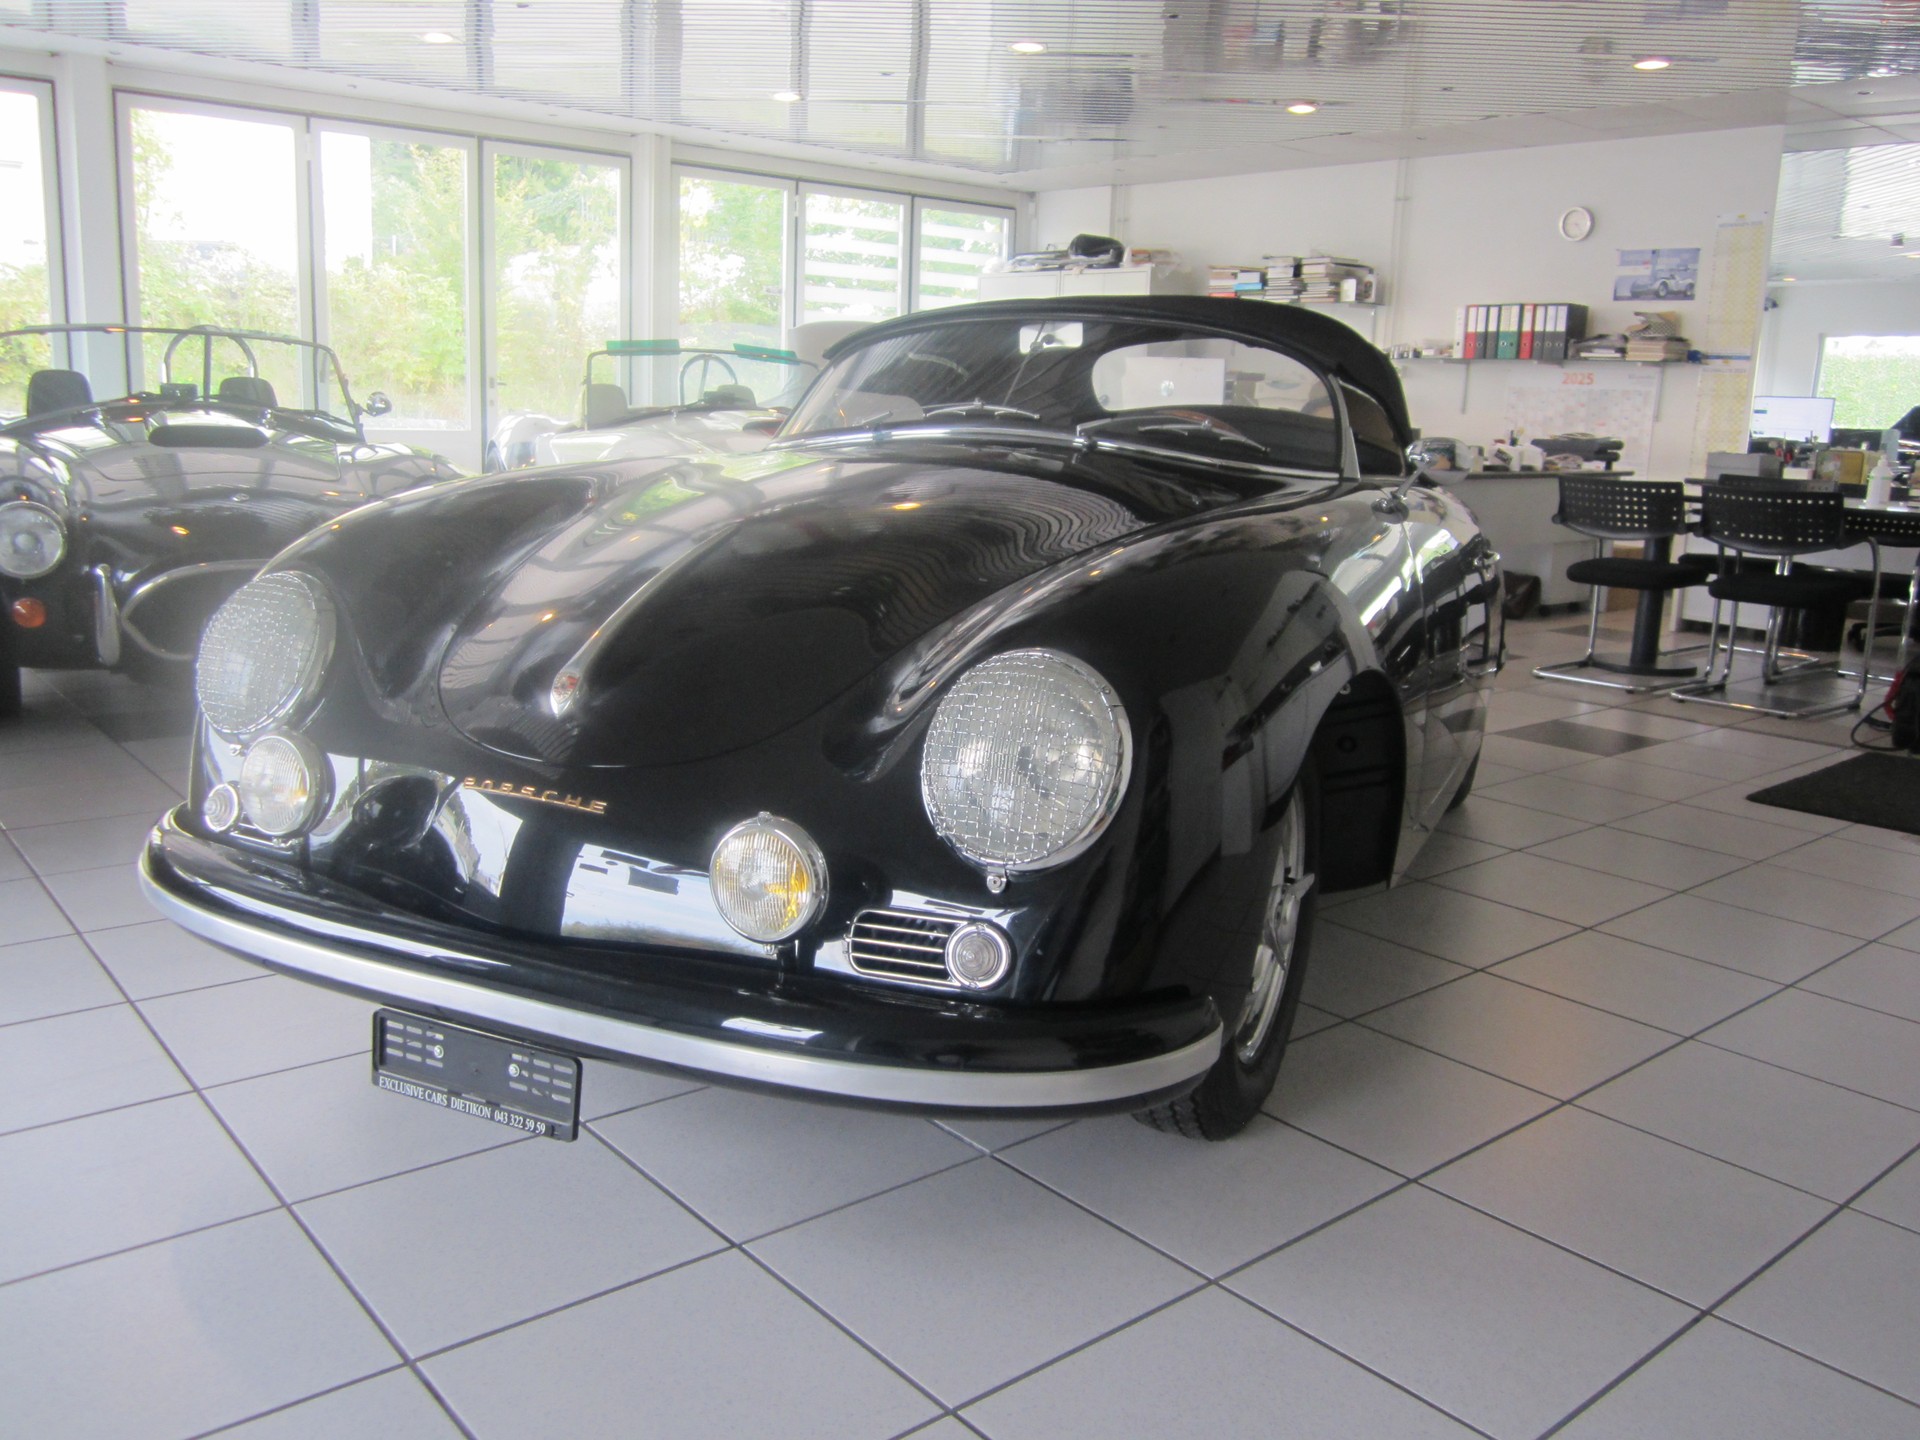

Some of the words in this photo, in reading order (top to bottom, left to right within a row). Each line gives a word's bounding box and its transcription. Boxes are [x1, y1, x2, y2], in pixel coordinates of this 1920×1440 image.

[1562, 372, 1595, 385] 2025
[463, 777, 607, 813] PORSCHE
[379, 1076, 425, 1099] EXCLUSIVE
[425, 1090, 448, 1106] CARS
[450, 1096, 492, 1119] DIETIKON
[494, 1110, 508, 1124] 043
[509, 1114, 524, 1129] 322
[524, 1118, 535, 1131] 59
[535, 1121, 546, 1135] 59
